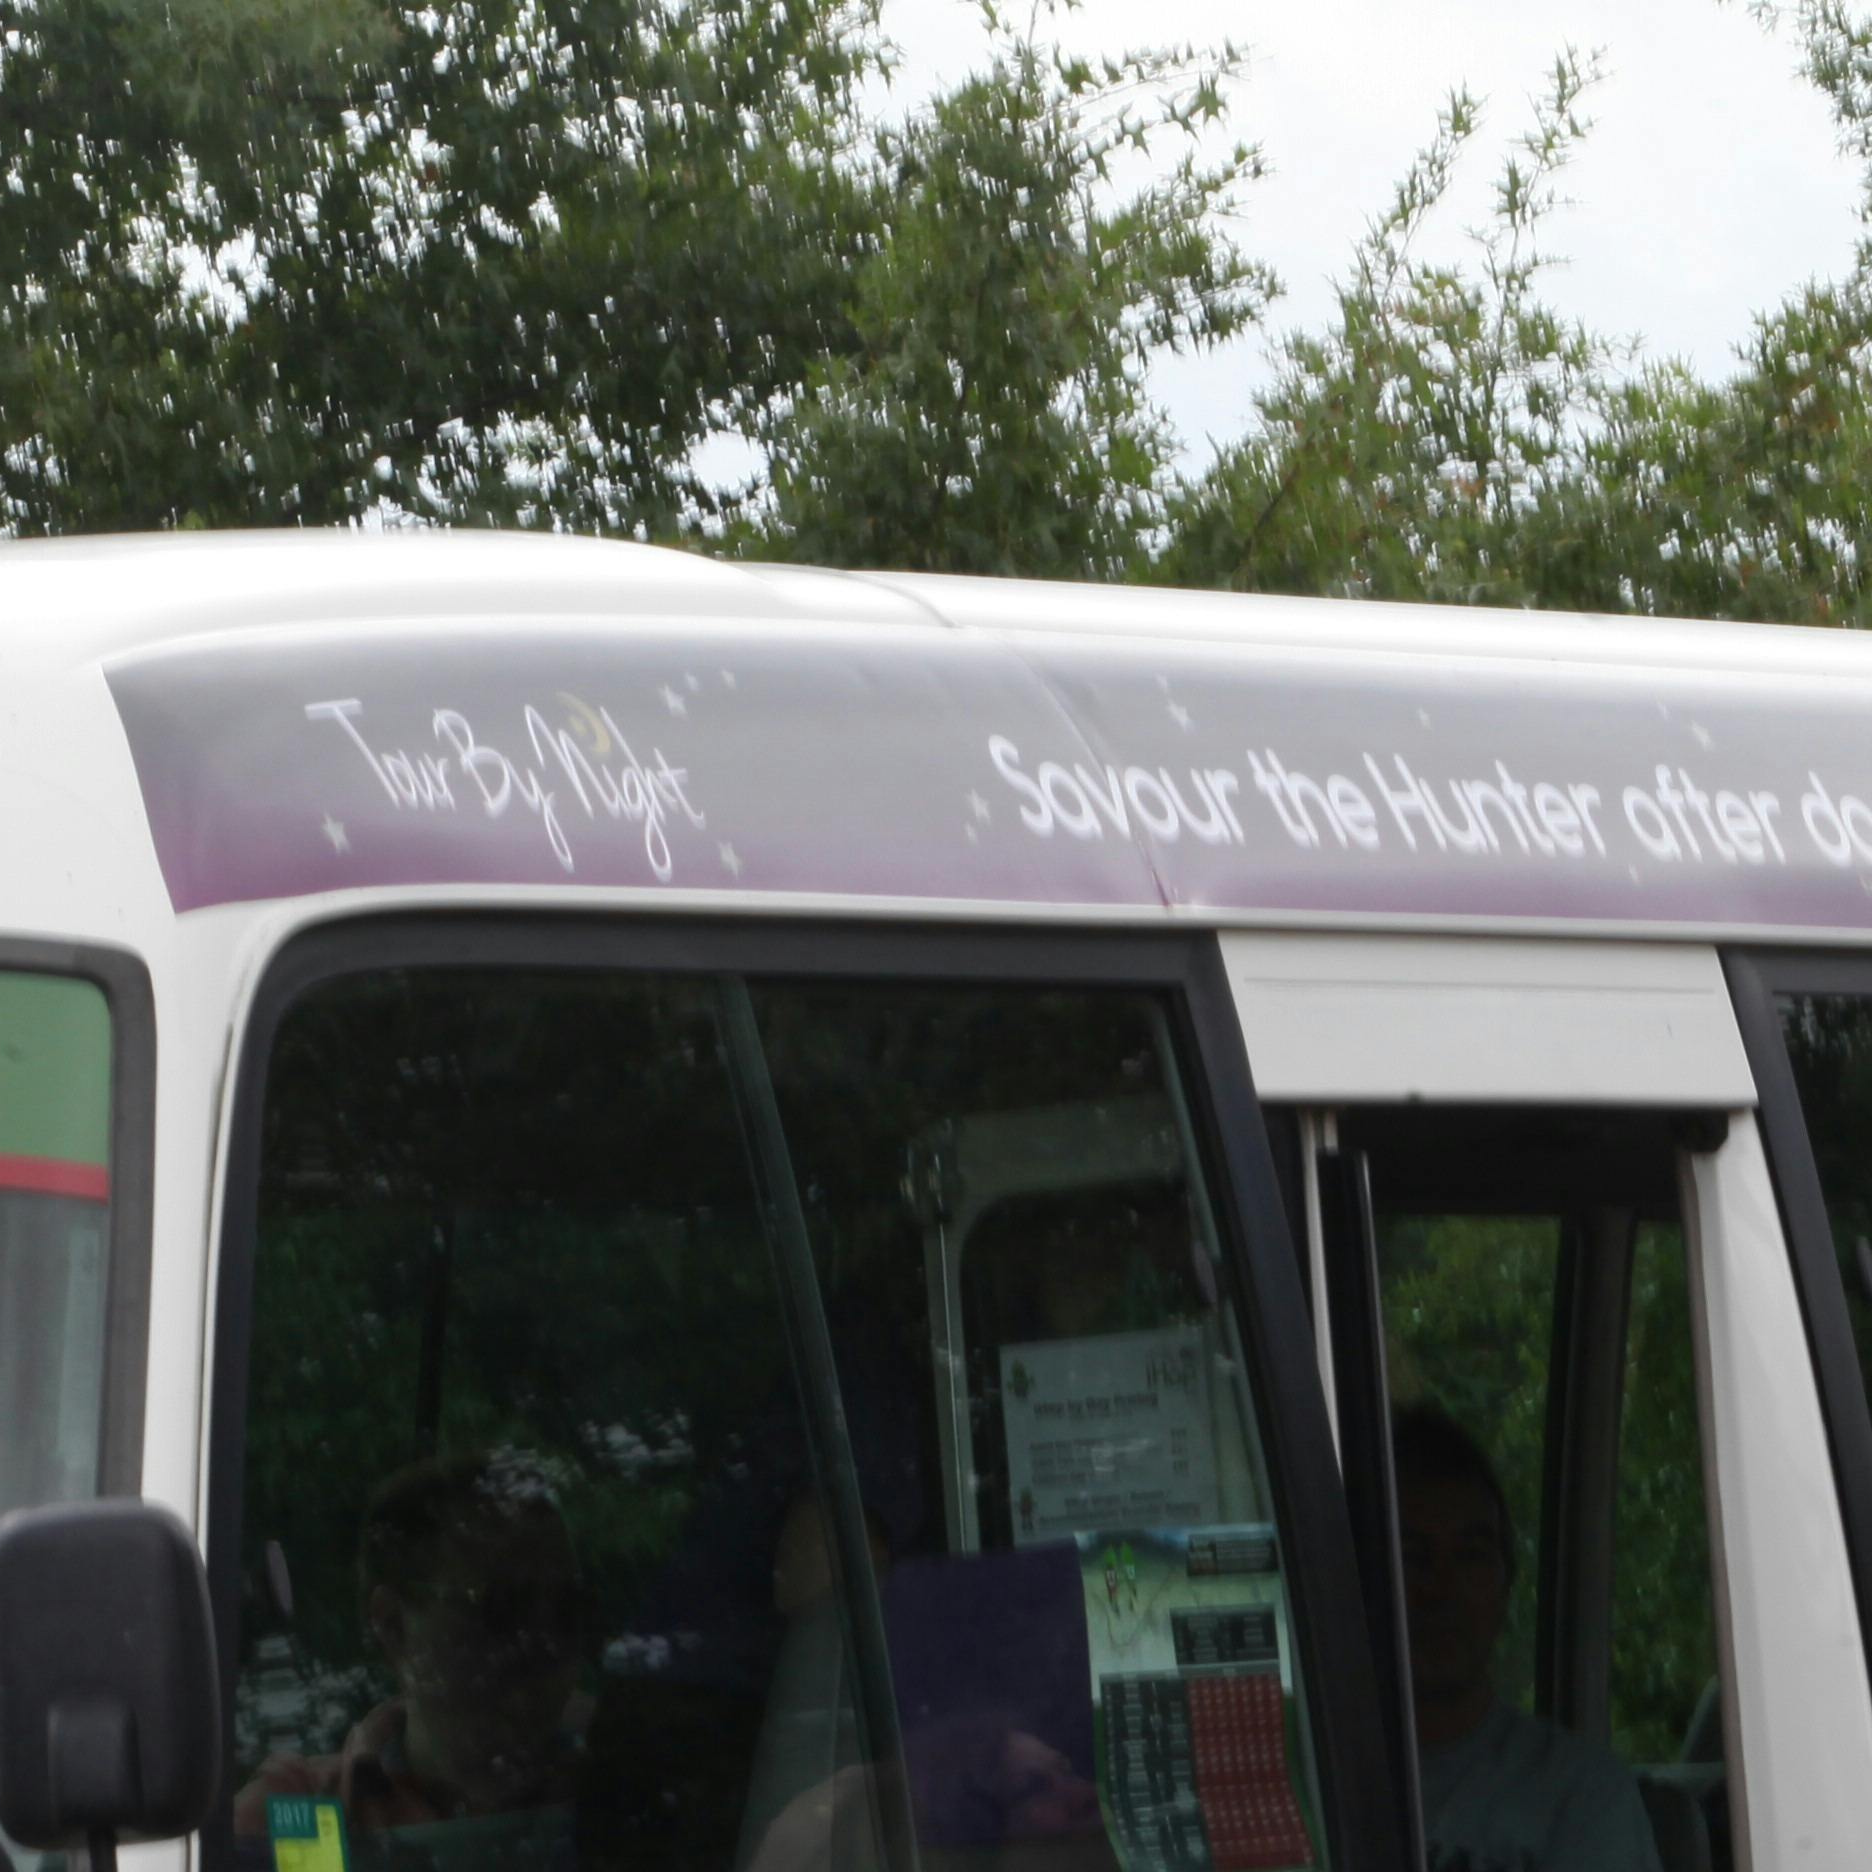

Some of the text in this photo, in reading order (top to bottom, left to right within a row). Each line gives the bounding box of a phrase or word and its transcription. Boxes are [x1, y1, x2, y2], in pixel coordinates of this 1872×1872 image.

[305, 690, 706, 882] Tour By Night
[989, 732, 1239, 845] Savour
[1248, 746, 1376, 852] the
[1364, 751, 1606, 859] Hunter
[1623, 762, 1786, 866] after
